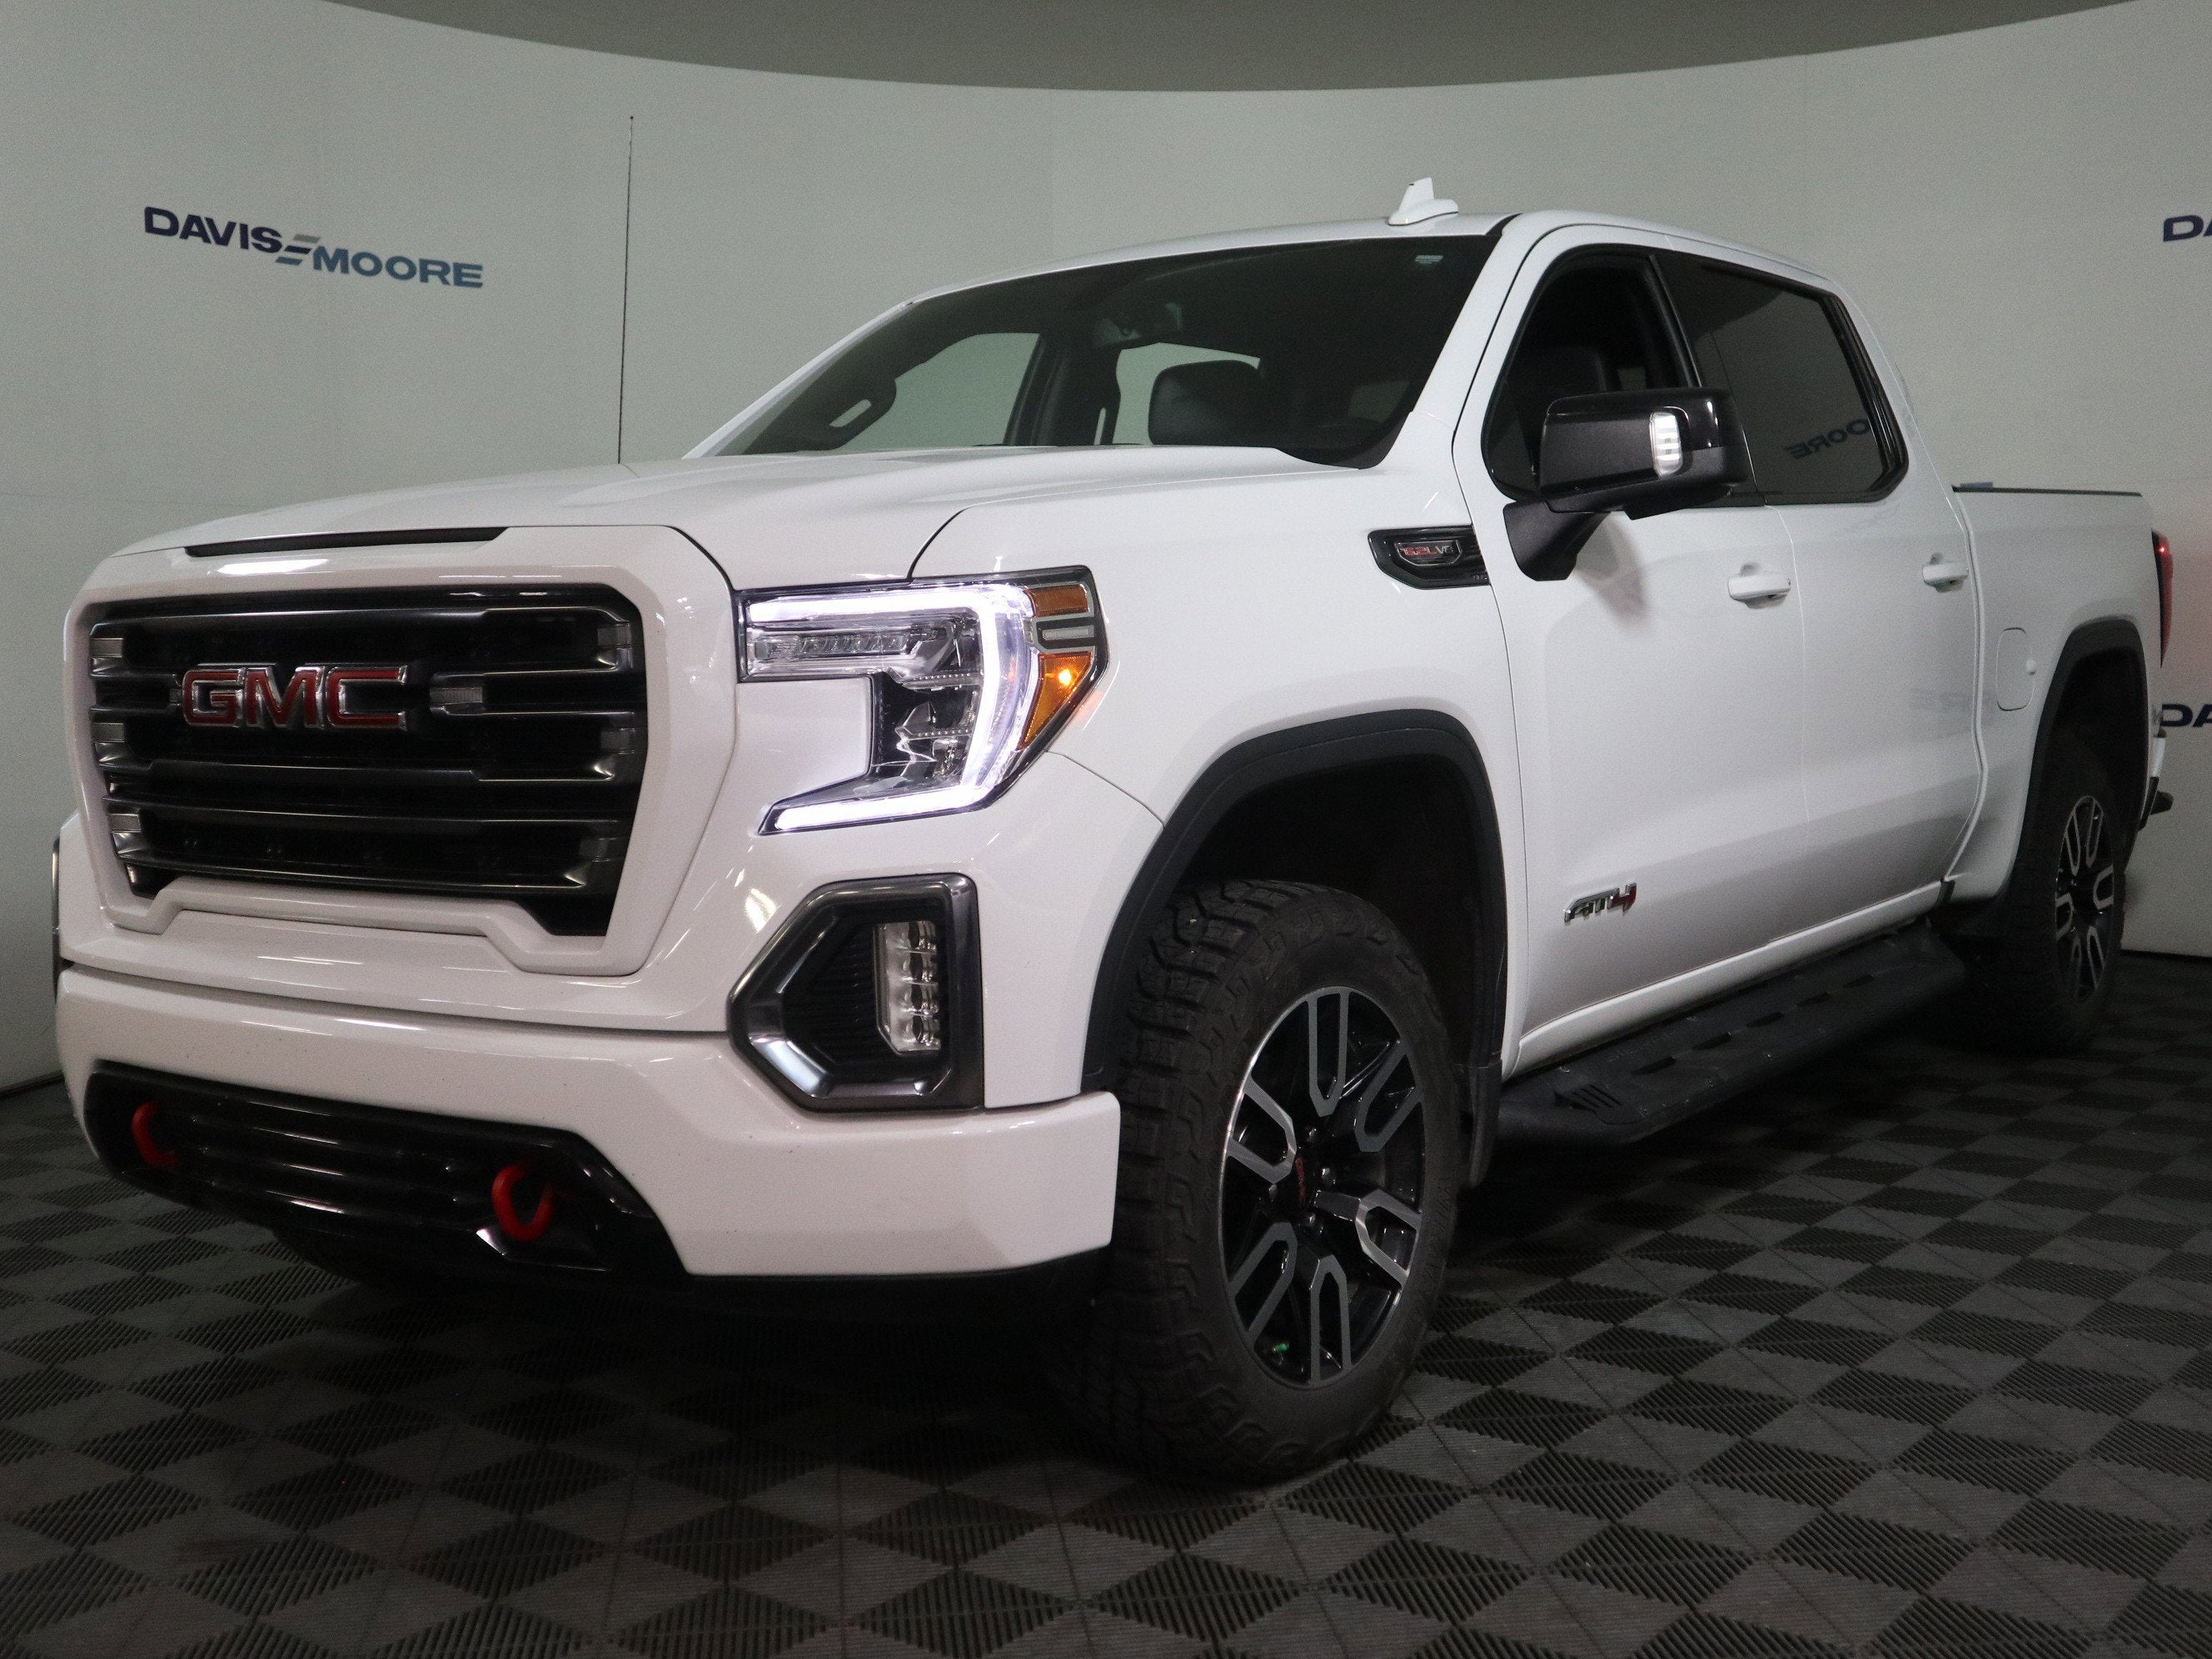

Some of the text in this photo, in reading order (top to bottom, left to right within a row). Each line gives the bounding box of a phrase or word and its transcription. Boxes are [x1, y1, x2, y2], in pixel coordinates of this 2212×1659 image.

[144, 206, 483, 288] DAVIS MOORE
[182, 665, 407, 730] GMC
[1564, 882, 1637, 923] AT4
